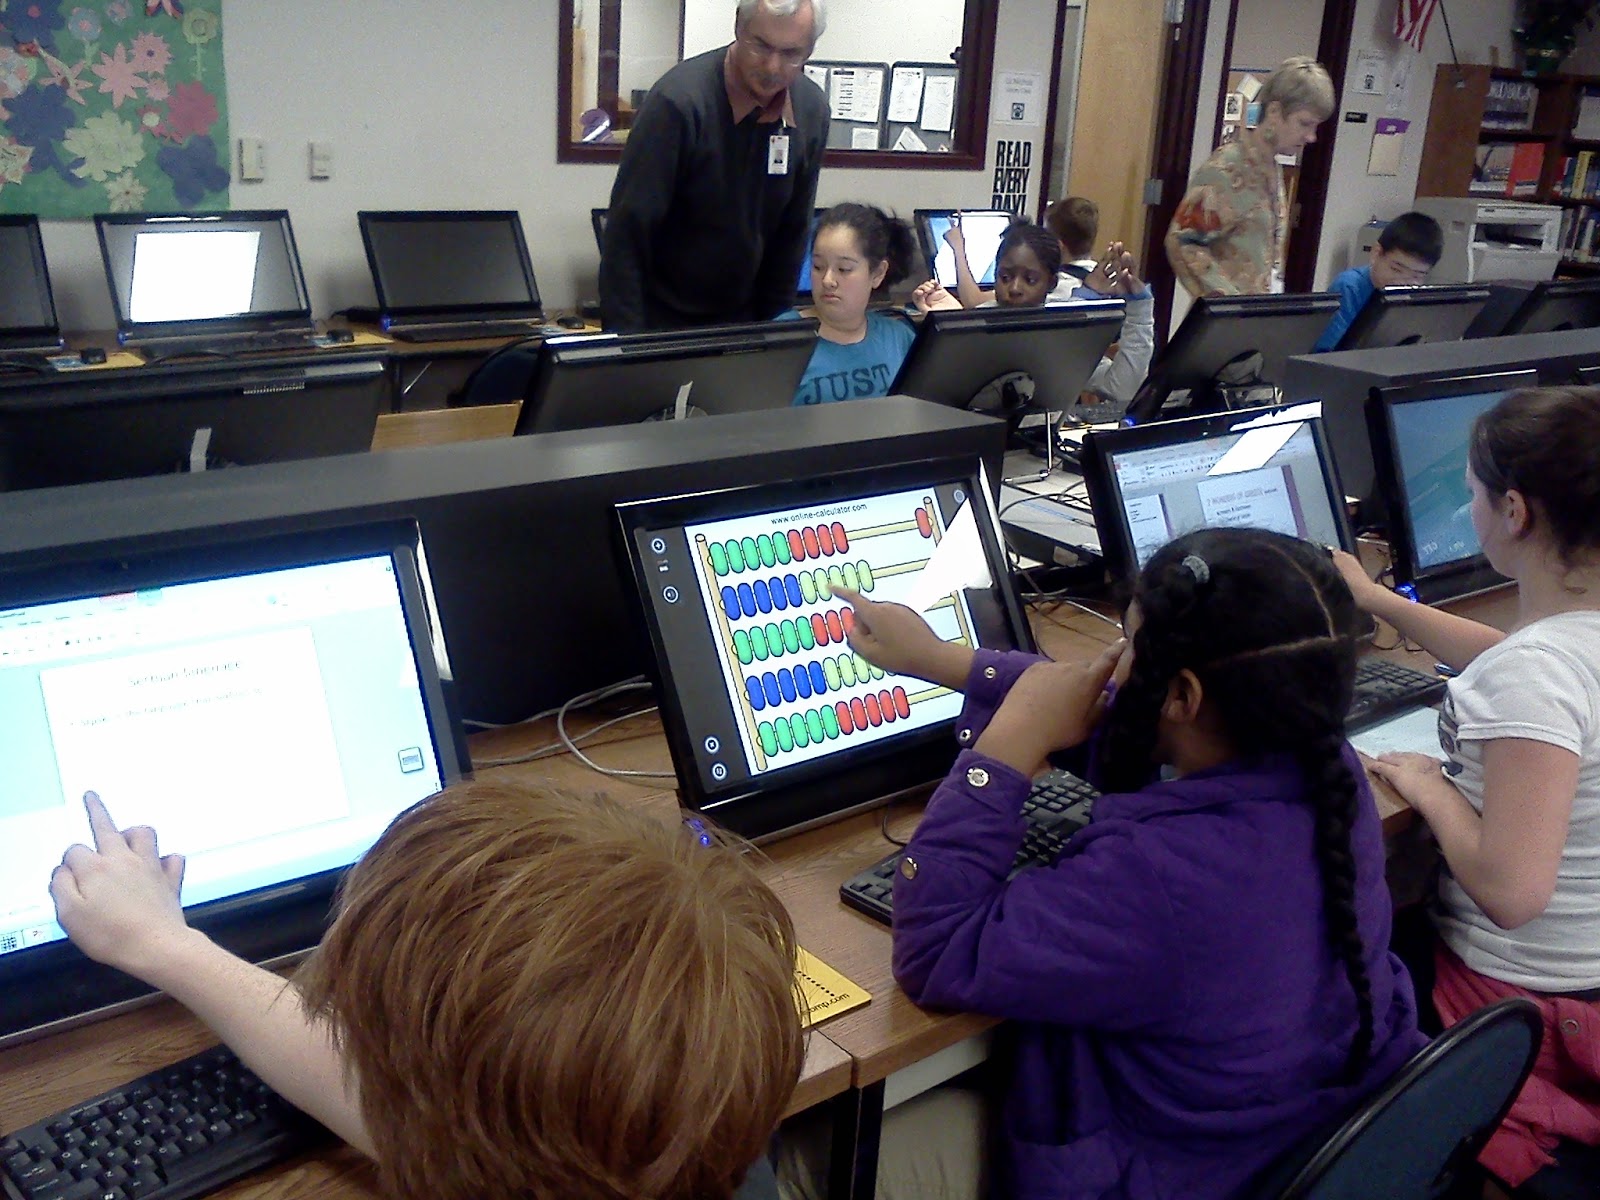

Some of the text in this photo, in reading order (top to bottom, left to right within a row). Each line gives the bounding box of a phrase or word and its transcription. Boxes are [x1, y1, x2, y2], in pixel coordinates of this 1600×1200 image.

[995, 140, 1032, 167] READ
[992, 167, 1030, 194] EVERY
[803, 363, 890, 405] JUST
[809, 993, 850, 1013] omp.com
